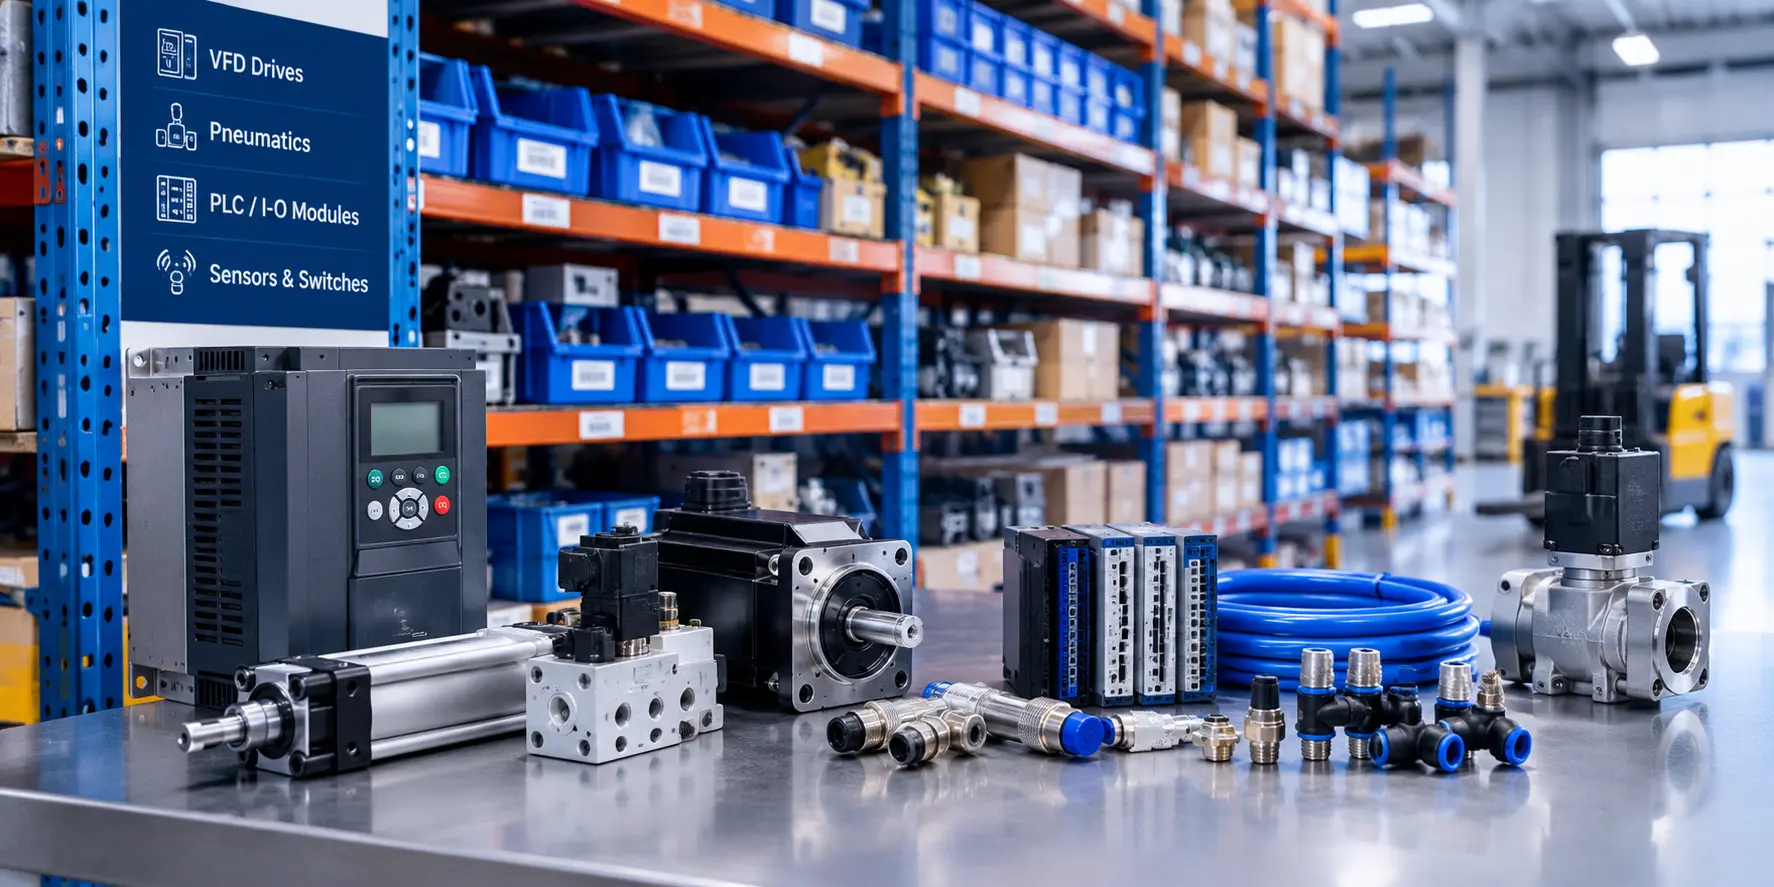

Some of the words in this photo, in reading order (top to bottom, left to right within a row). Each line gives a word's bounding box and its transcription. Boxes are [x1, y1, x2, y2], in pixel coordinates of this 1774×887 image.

[209, 48, 246, 73] VFD
[252, 56, 304, 83] Drives
[210, 121, 311, 153] Pneumatics
[210, 192, 245, 215] PLC
[249, 196, 258, 217] /
[262, 198, 287, 219] I-O
[292, 201, 360, 226] Modules
[210, 263, 278, 287] Sensors
[282, 268, 294, 288] &
[298, 269, 369, 293] Switches
